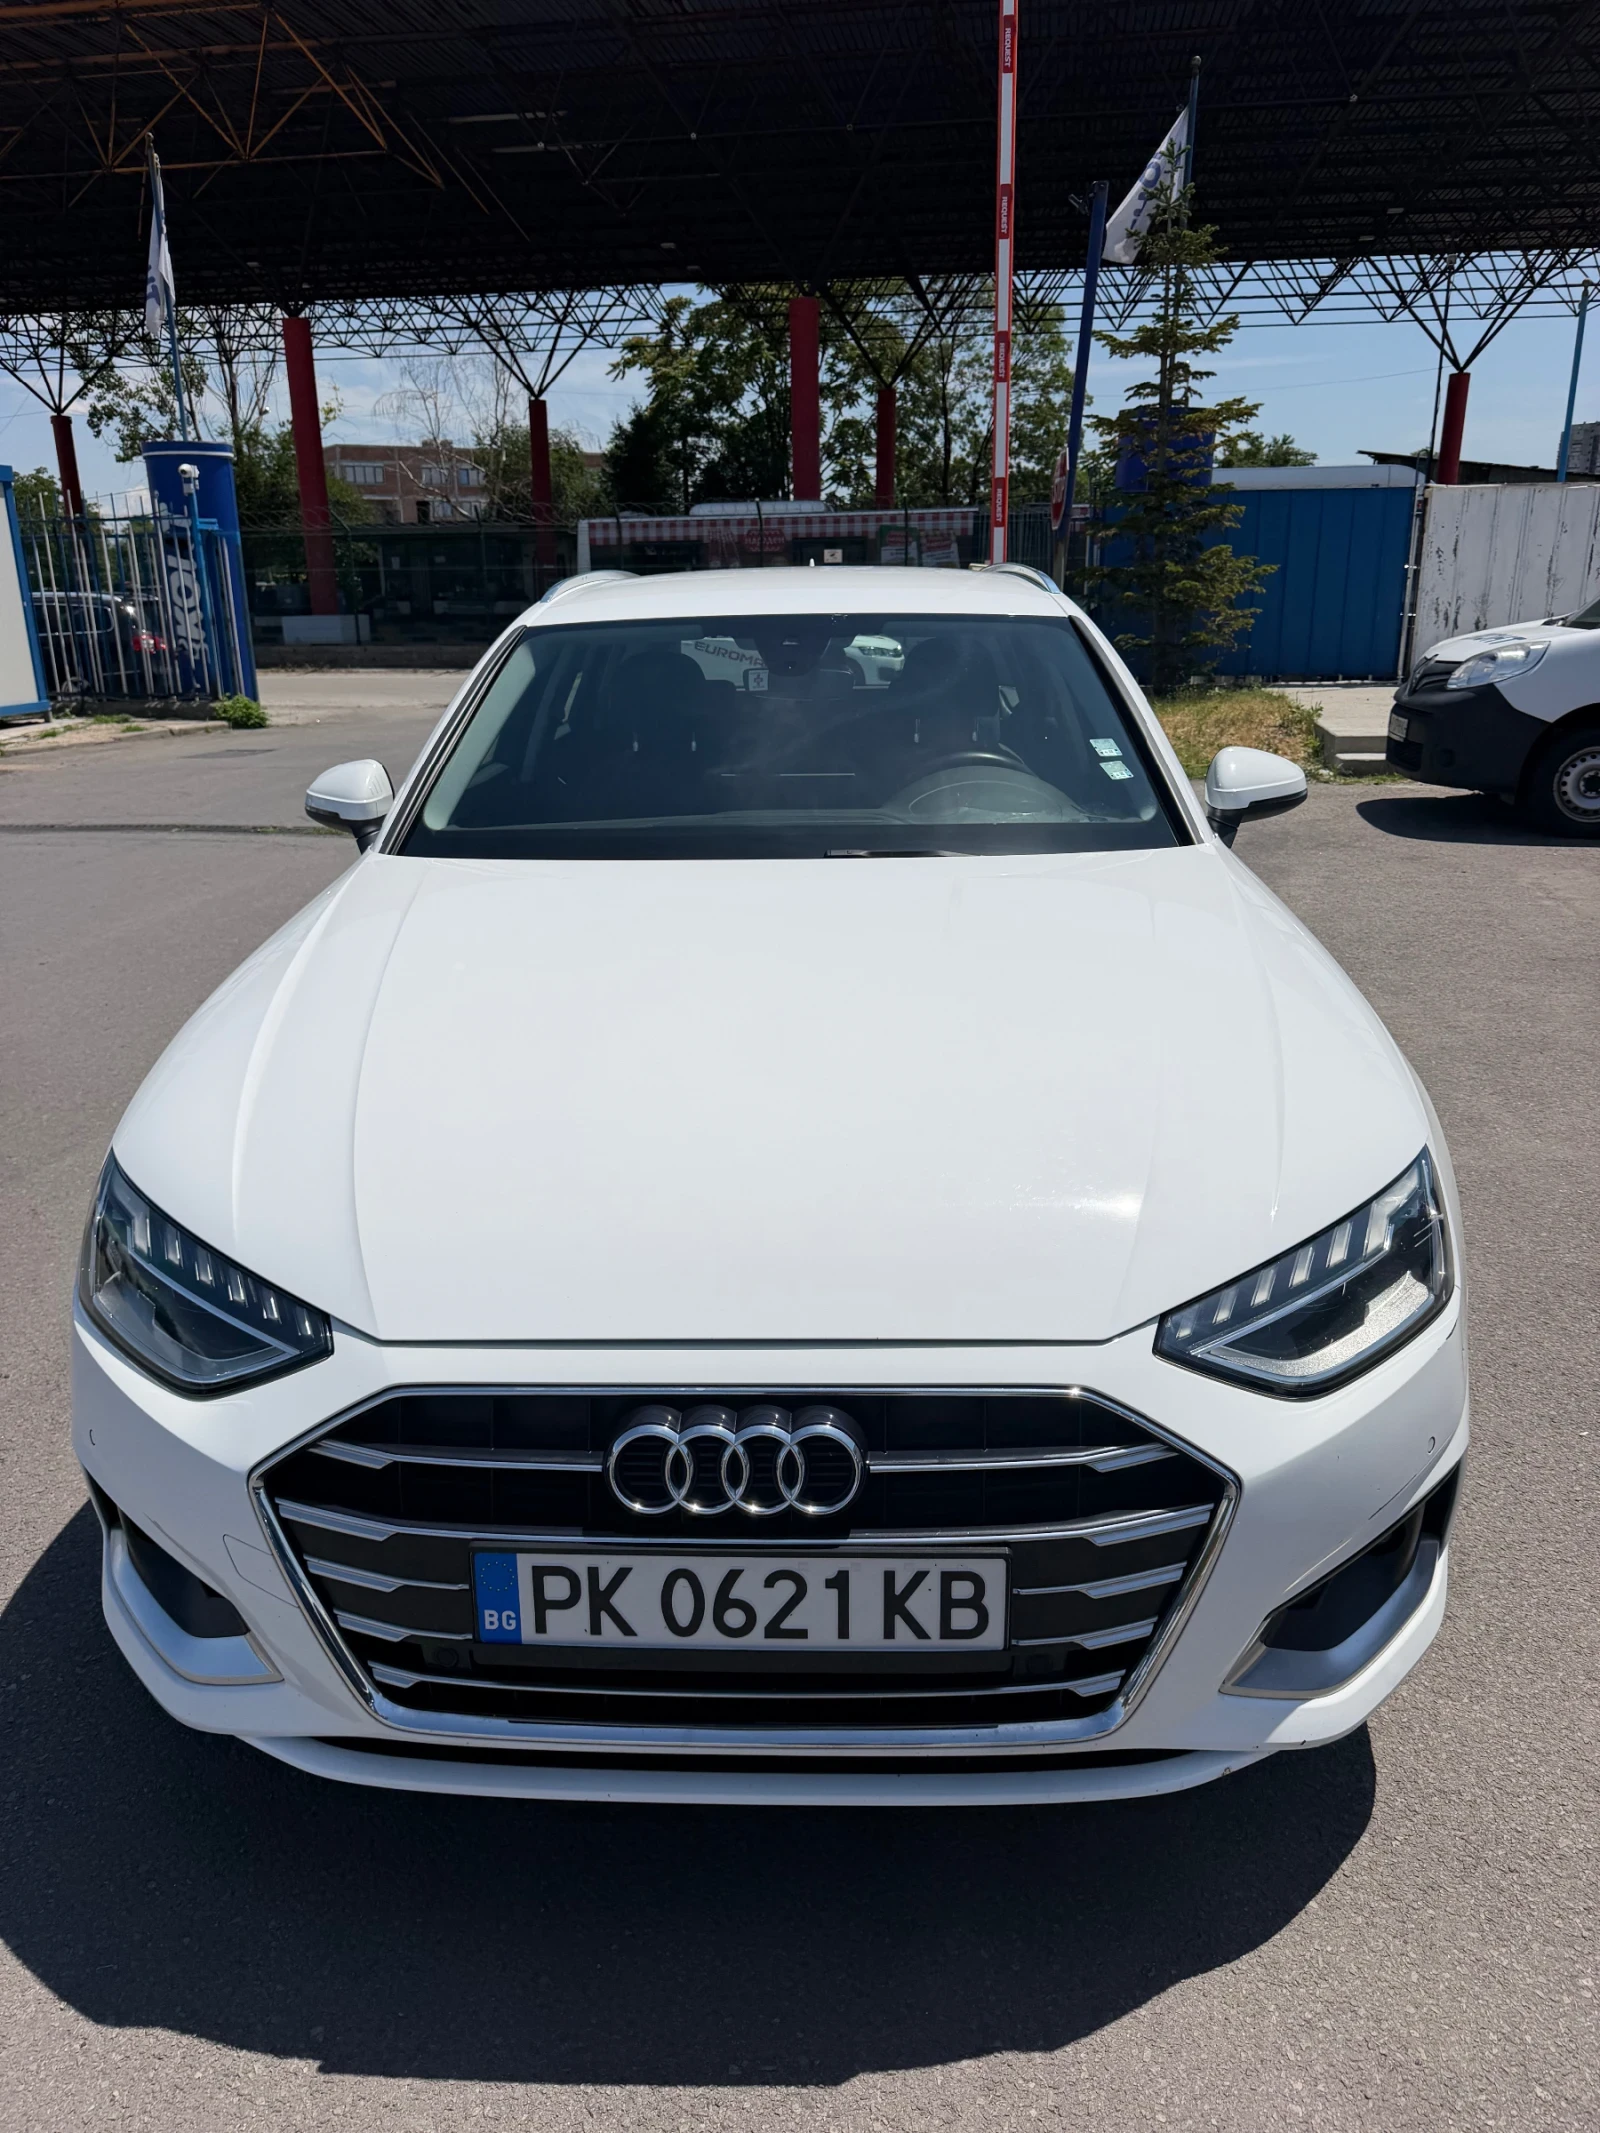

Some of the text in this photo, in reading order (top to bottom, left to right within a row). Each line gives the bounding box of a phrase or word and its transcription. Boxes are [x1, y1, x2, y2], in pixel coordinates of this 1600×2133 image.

[1004, 27, 1012, 68] REQUEST
[1000, 196, 1008, 234] REQUEST
[998, 342, 1006, 378] REQUEST
[995, 488, 1003, 522] REQUEST
[484, 1609, 517, 1631] BG
[531, 1564, 990, 1641] PK 0621 KB
